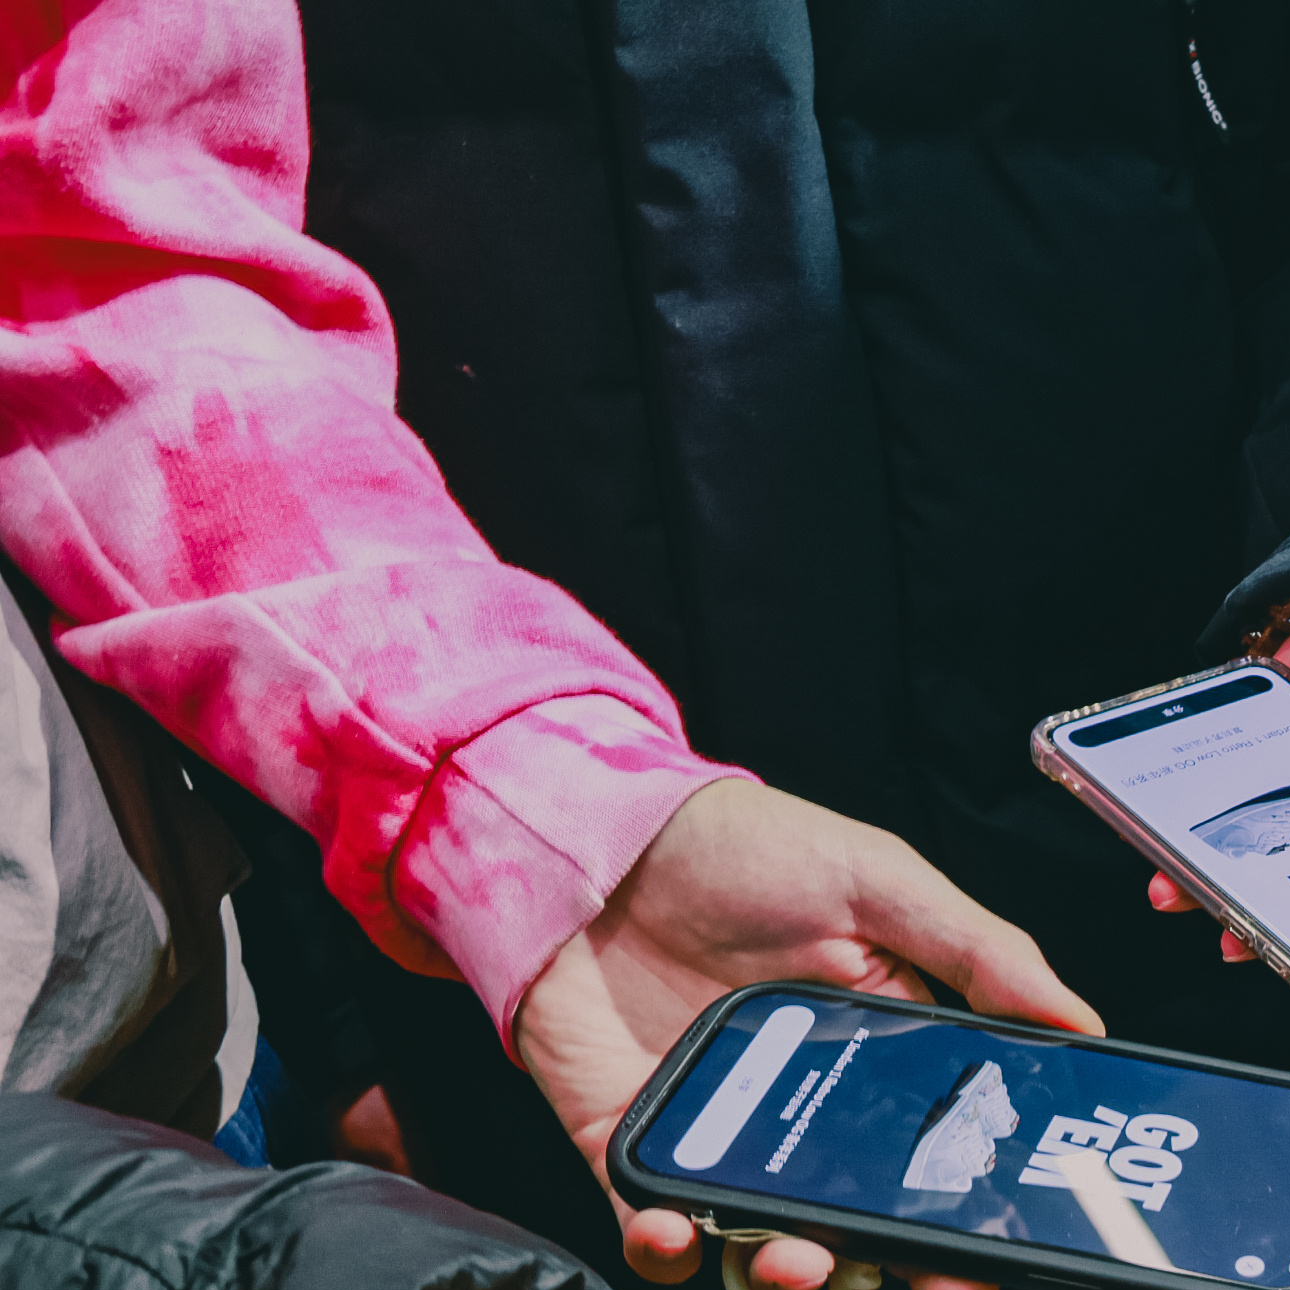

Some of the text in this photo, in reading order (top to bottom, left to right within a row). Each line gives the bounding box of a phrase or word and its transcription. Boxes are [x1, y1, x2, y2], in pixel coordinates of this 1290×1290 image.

[1218, 738, 1254, 754] Retro
[1252, 735, 1264, 743] 1
[1193, 749, 1223, 763] Low
[1171, 757, 1198, 770] OG
[1085, 1108, 1208, 1211] GOT
